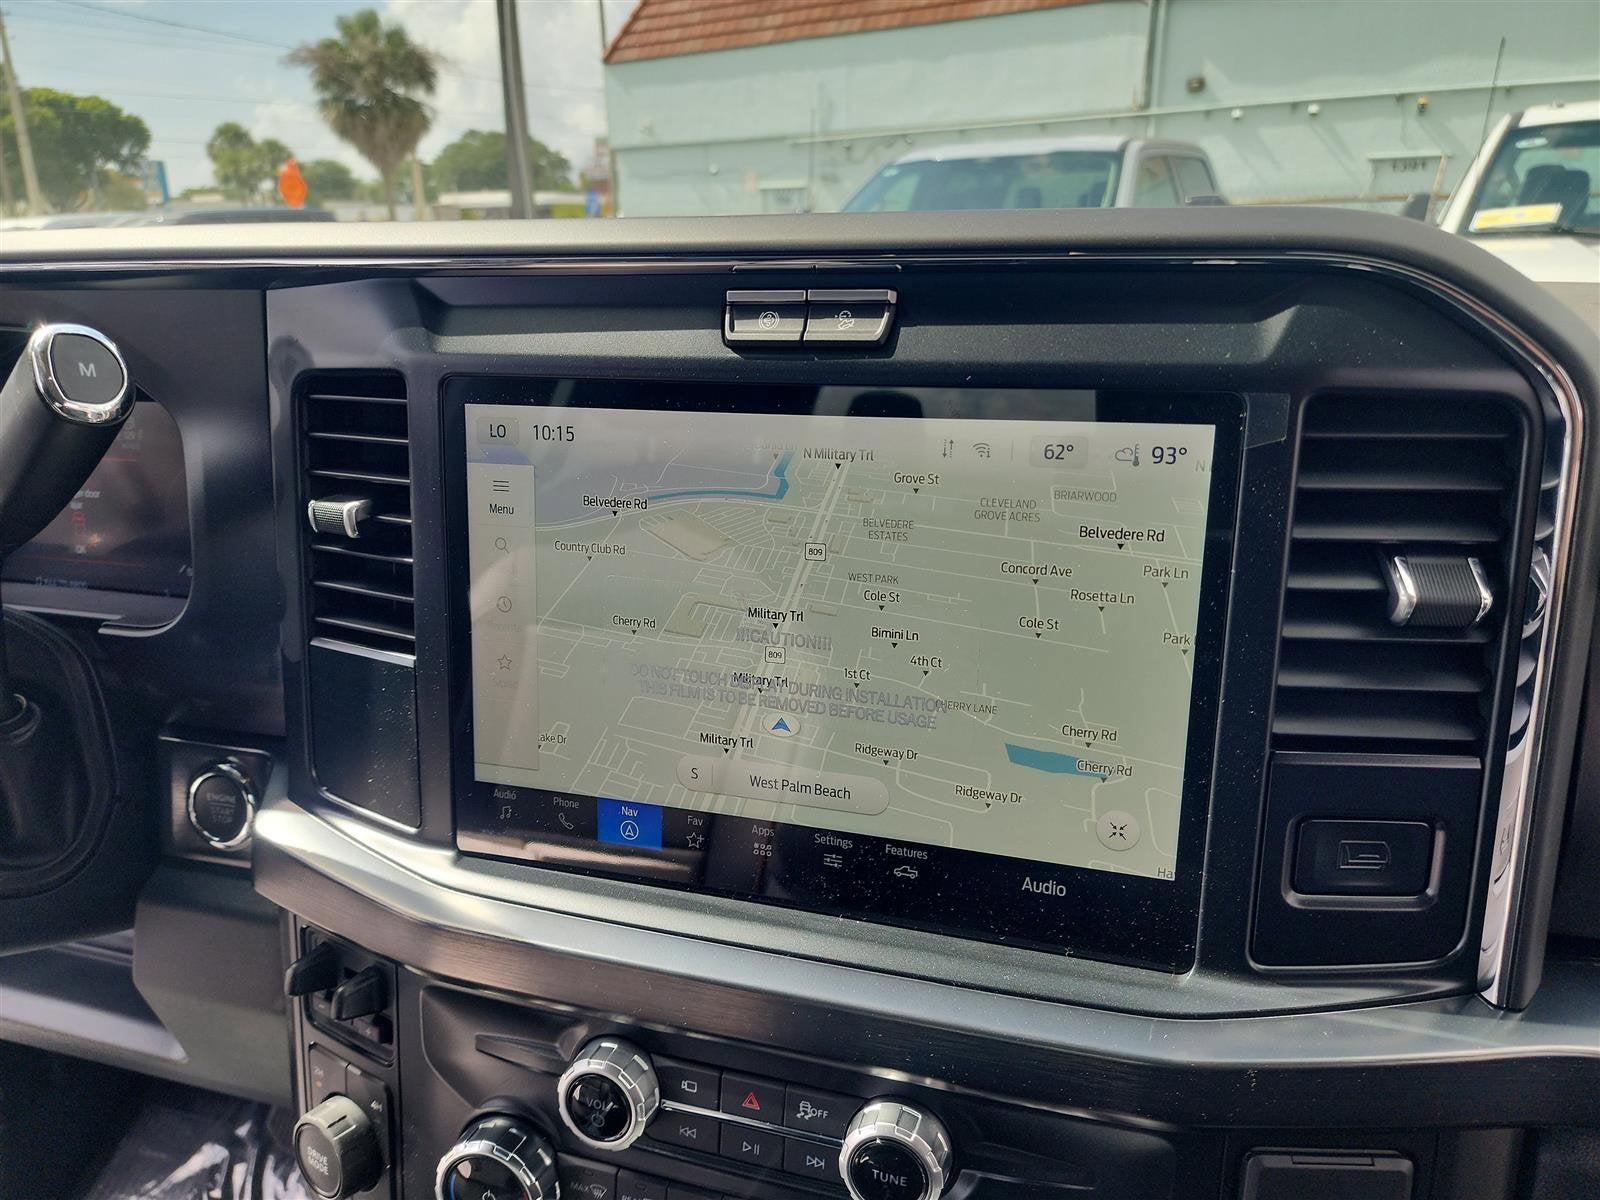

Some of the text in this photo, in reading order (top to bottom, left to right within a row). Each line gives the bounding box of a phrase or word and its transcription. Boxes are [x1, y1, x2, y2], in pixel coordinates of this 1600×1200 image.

[79, 362, 97, 378] M
[489, 424, 506, 438] LO
[533, 425, 575, 442] 10:15
[803, 448, 874, 462] N Military Trl
[1043, 444, 1074, 460] 62°
[1151, 446, 1188, 465] 93°
[894, 472, 940, 485] Grove St
[583, 495, 647, 510] Belvedere Rd
[980, 497, 1037, 509] CLEVELAND
[1054, 490, 1117, 502] BRIARWOOD
[489, 504, 514, 515] Menu
[974, 509, 1041, 523] GROVE ACRES
[862, 517, 914, 530] BELVEDERE
[868, 530, 909, 542] ESTATES
[1079, 525, 1165, 542] Belvedere Rd
[554, 540, 626, 555] Country Club Rd
[808, 547, 823, 557] 809
[1001, 562, 1073, 577] Concord Ave
[1143, 565, 1189, 579] Park Ln
[848, 572, 899, 585] WEST PARK
[863, 590, 900, 603] Cole St
[1070, 589, 1135, 604] Rosetta Ln
[612, 615, 656, 628] Cherry Rd
[748, 607, 804, 623] Military Trl
[1019, 616, 1060, 630] Cole St
[871, 627, 919, 641] Bimini Ln
[1163, 632, 1191, 645] Park
[768, 651, 783, 659] 809
[910, 655, 942, 668] 4th Ct
[733, 672, 789, 688] Military Trl
[844, 668, 871, 680] 1st Ct
[789, 681, 842, 700] DURING
[759, 694, 827, 715] REMOVED
[829, 702, 886, 722] BEFORE
[888, 710, 937, 730] USAGE
[935, 699, 998, 715] CHERRY LANE
[557, 734, 568, 744] Dr
[700, 732, 754, 748] Military Trl
[1062, 725, 1117, 741] Cherry Rd
[855, 743, 918, 760] Ridgeway Dr
[1077, 759, 1132, 777] Cherry Rd
[690, 768, 851, 799] S West Palm Beach
[493, 788, 517, 800] Audio
[955, 785, 1023, 804] Ridgeway Dr
[553, 796, 580, 809] Phone
[621, 805, 639, 817] Nav
[687, 815, 704, 827] Fav
[751, 825, 775, 837] Apps
[814, 833, 853, 849] Settings
[885, 843, 928, 860] Features
[1021, 876, 1067, 897] Audio
[811, 1107, 829, 1119] OFF
[871, 1168, 908, 1187] TUNE
